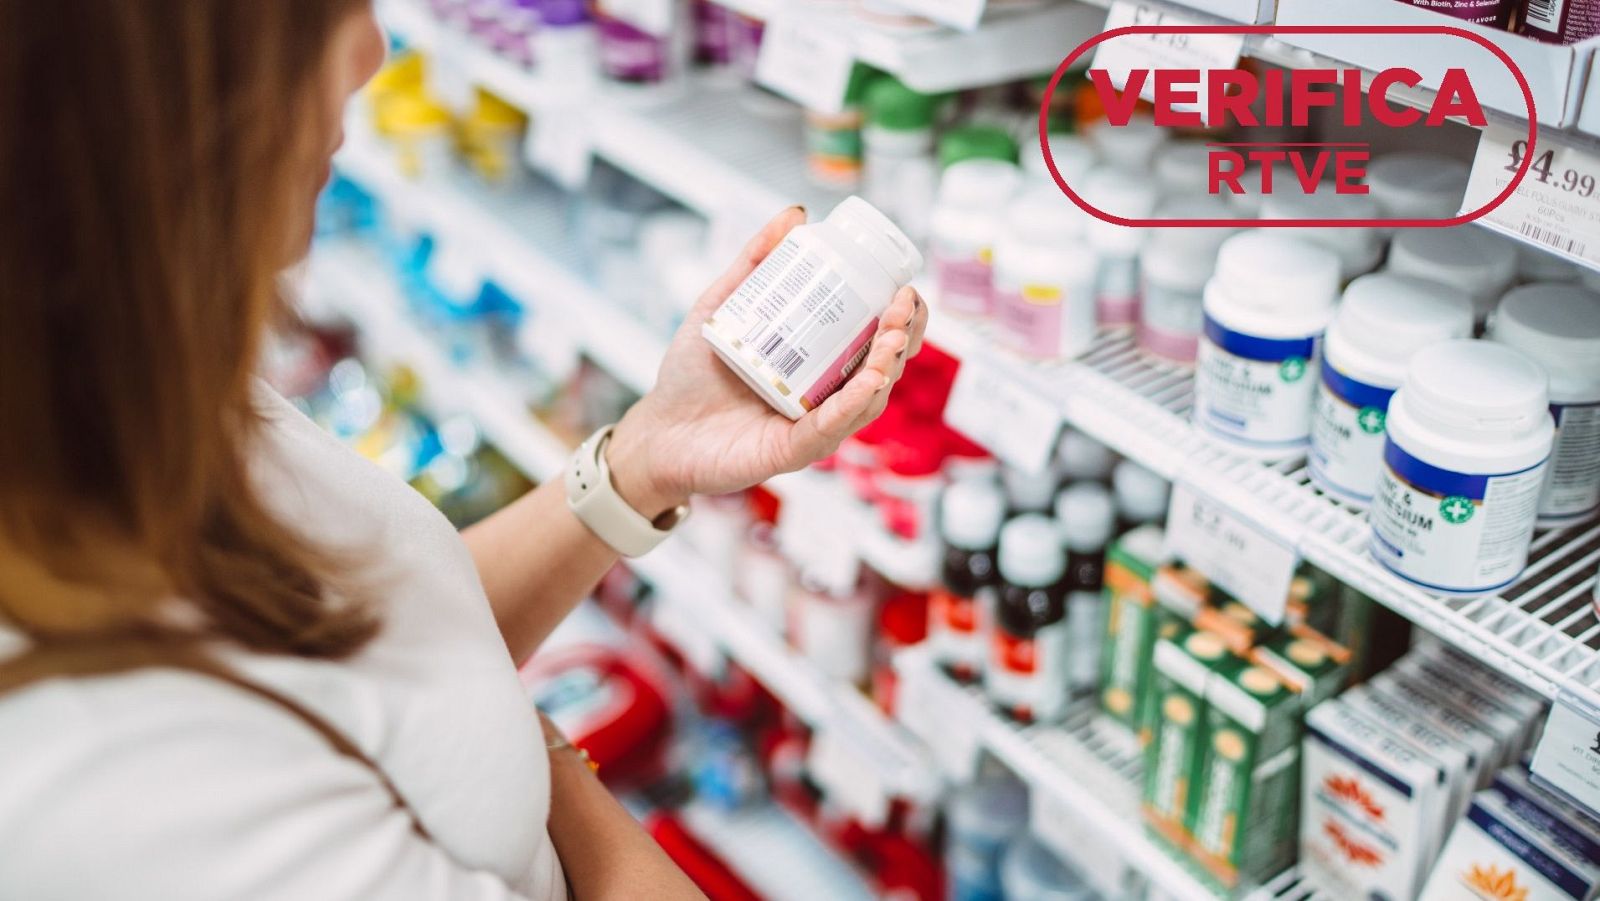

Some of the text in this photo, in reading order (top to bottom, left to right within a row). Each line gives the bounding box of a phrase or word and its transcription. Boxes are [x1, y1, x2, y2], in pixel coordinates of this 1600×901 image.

[1430, 0, 1453, 8] Biotin,
[1454, 0, 1468, 8] Zinc
[1504, 140, 1596, 198] £4.99
